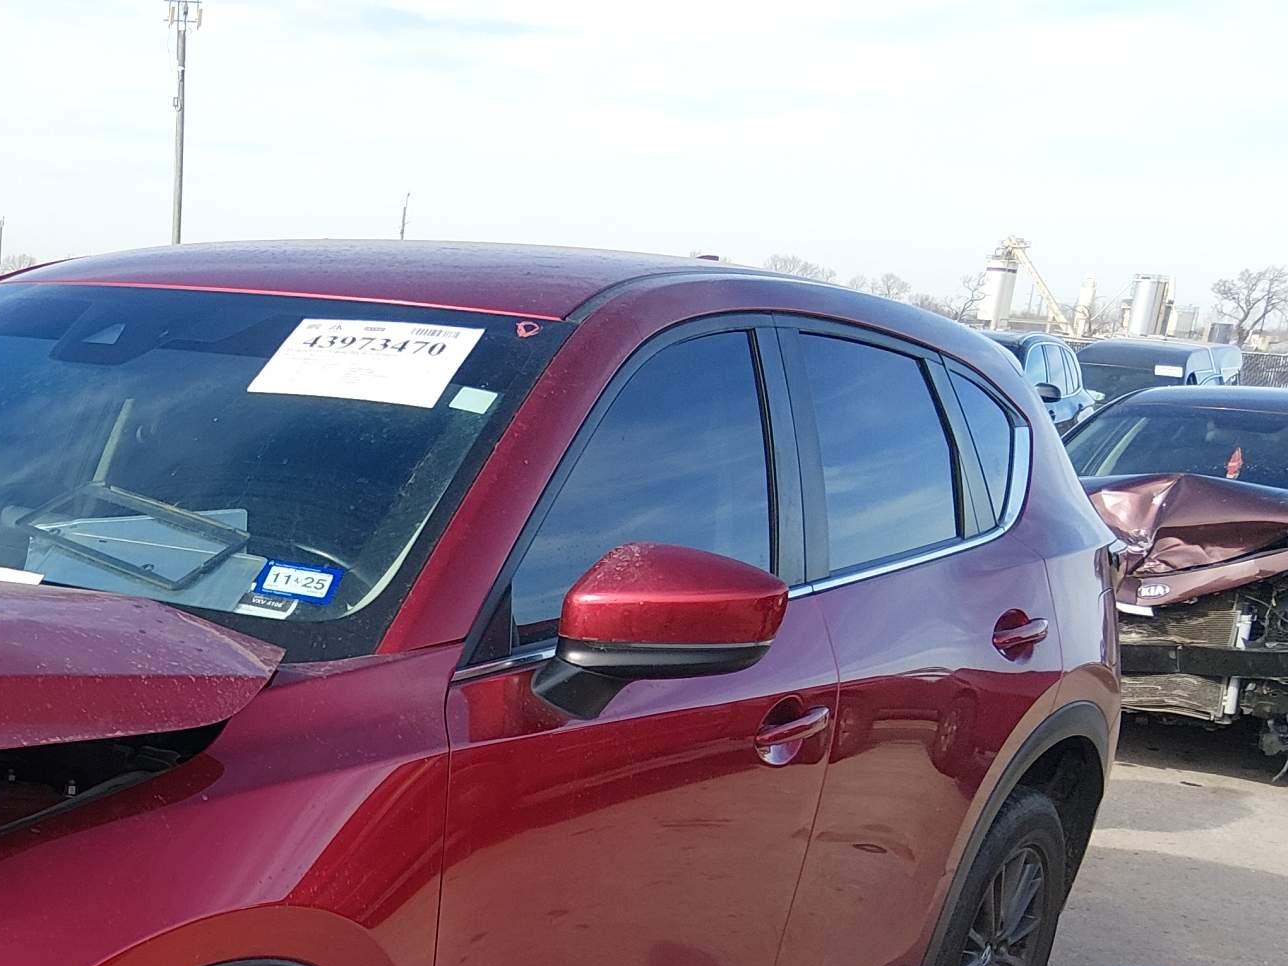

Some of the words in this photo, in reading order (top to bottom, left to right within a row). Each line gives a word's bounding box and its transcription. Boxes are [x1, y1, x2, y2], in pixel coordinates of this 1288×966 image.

[302, 335, 446, 357] 43973470
[272, 572, 292, 585] 11
[302, 576, 327, 590] 25
[1141, 586, 1166, 596] KIA
